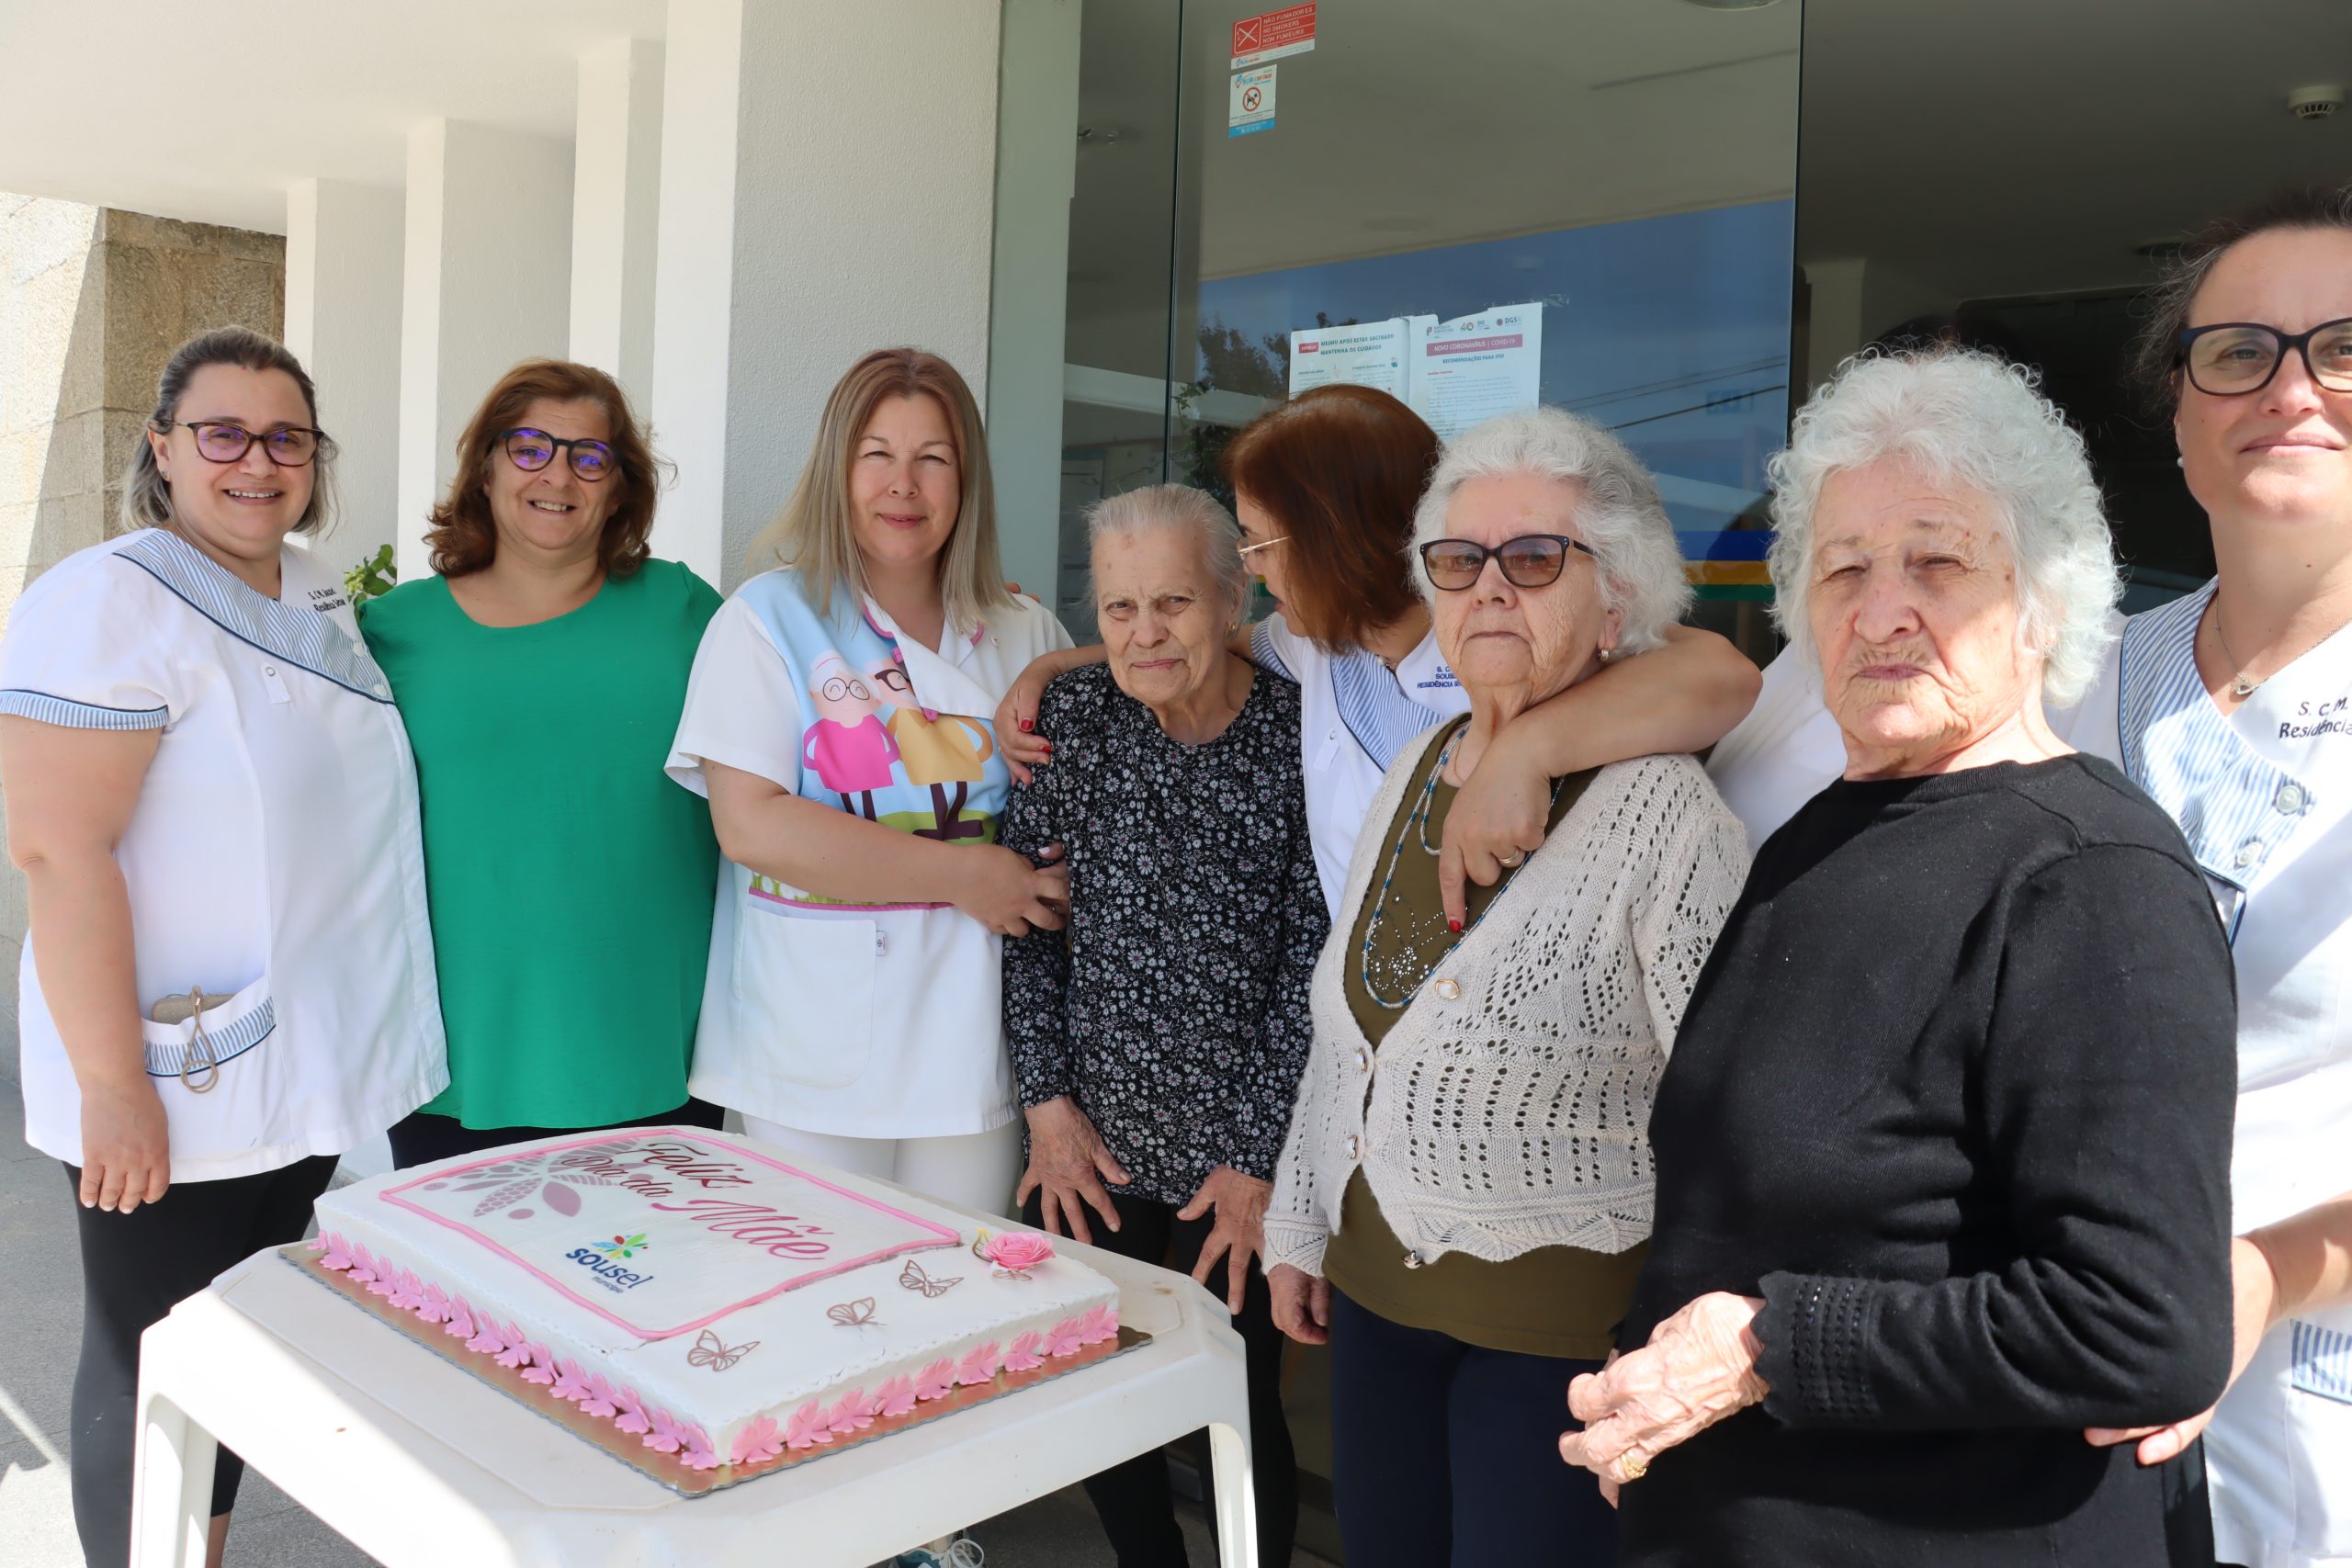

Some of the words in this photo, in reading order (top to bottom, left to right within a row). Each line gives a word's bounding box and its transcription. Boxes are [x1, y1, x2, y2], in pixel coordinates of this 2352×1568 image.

[1263, 16, 1276, 24] NÃO
[1272, 19, 1300, 31] SMOKERS
[1262, 35, 1275, 43] NON
[1276, 28, 1305, 40] FUMEURS
[1357, 344, 1382, 353] CUIDADOS
[1449, 339, 1487, 350] CORONAVÍRUS
[1491, 337, 1516, 346] COVID-19
[1417, 680, 1453, 689] RESIDÊNCIA
[617, 1142, 754, 1189] Feliz
[560, 1156, 629, 1178] Dia
[619, 1179, 673, 1198] da
[650, 1199, 834, 1260] Mãe
[565, 1247, 655, 1289] sousel
